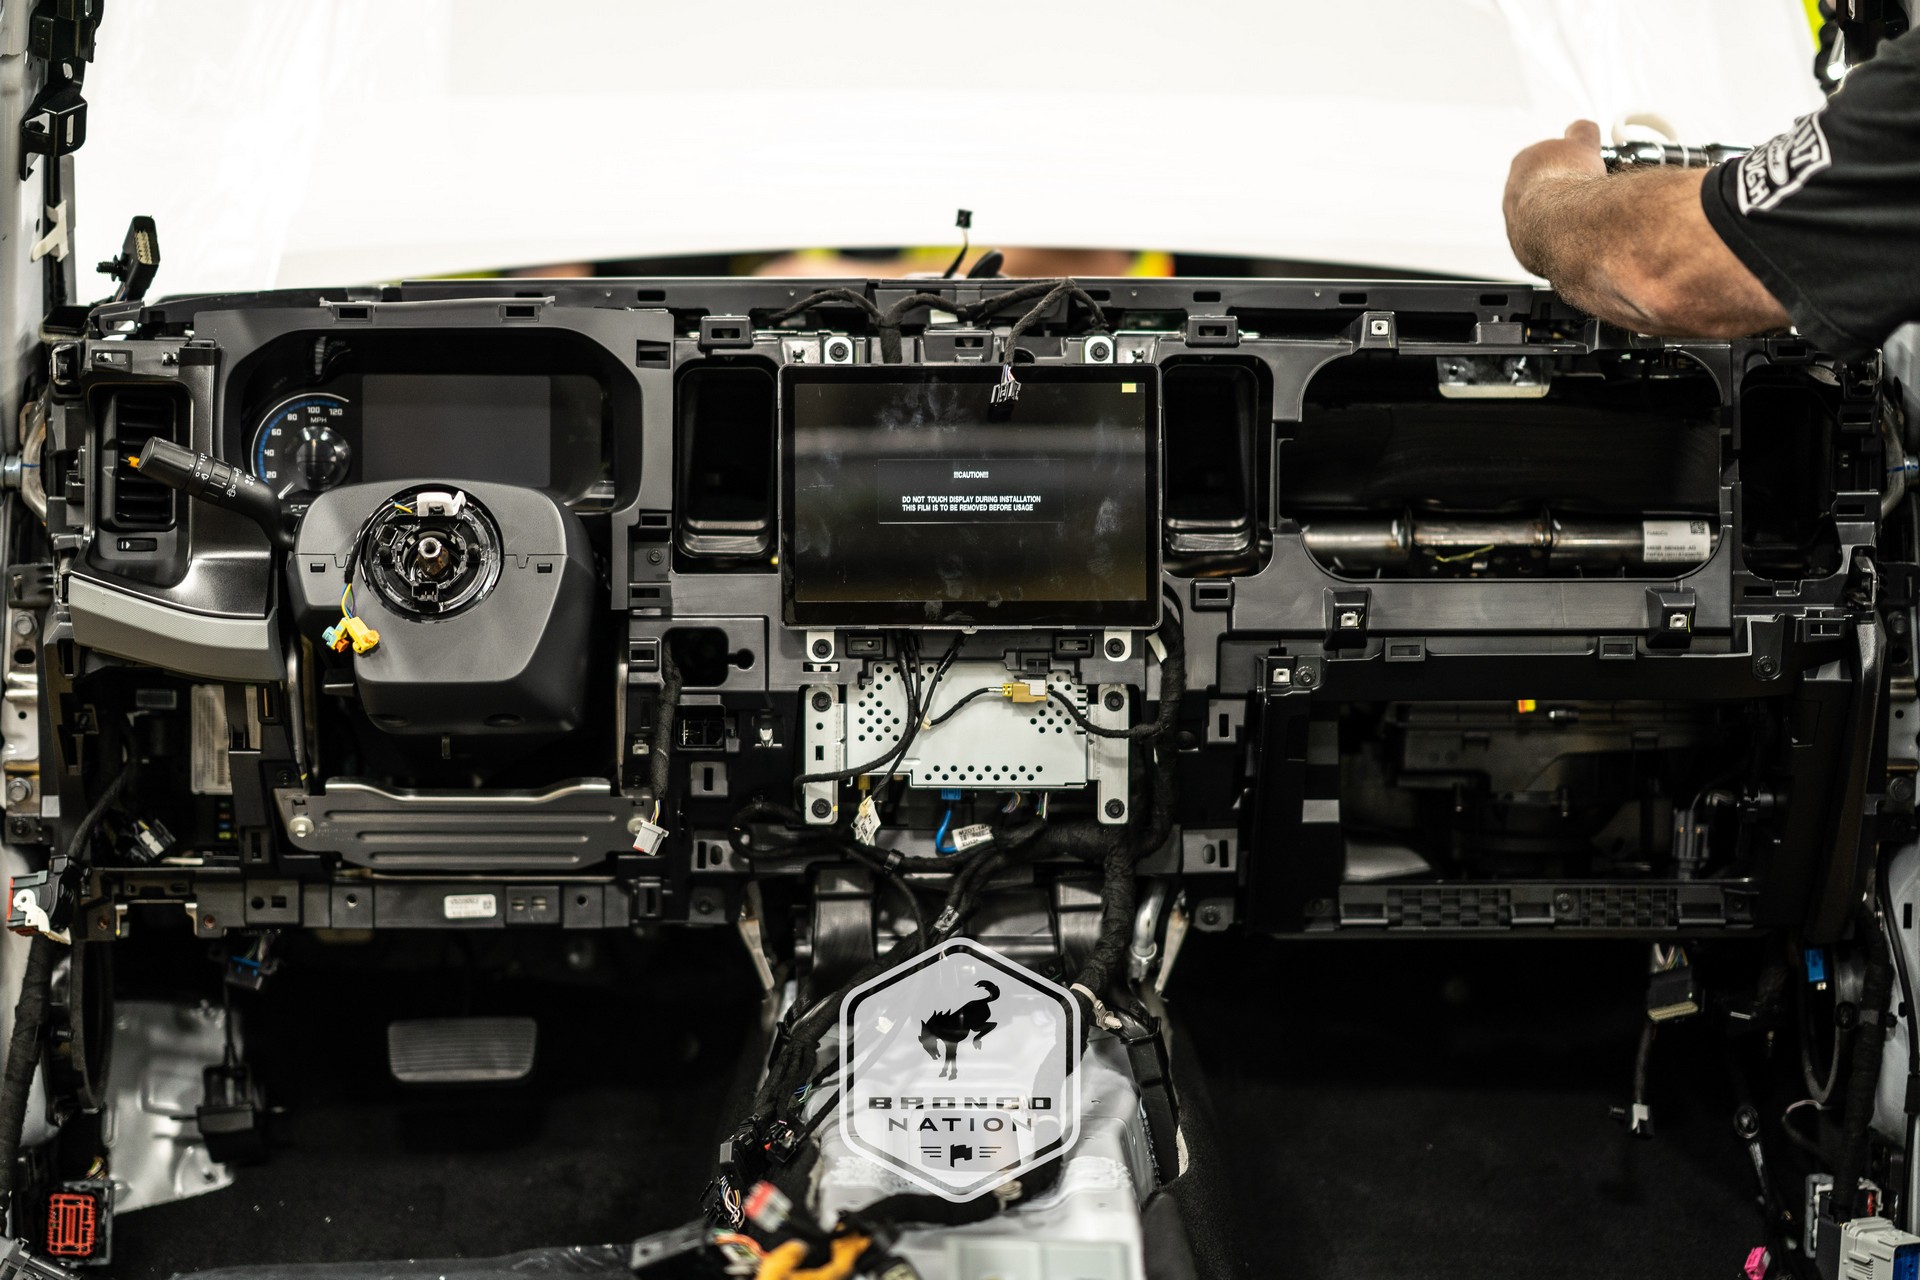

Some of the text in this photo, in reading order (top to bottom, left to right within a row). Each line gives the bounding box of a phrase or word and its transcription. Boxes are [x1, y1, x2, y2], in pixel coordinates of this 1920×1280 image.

[307, 406, 320, 414] 100
[328, 408, 343, 416] 120
[287, 413, 298, 421] 80
[271, 428, 282, 436] 60
[264, 449, 275, 457] 40
[266, 471, 277, 479] 20
